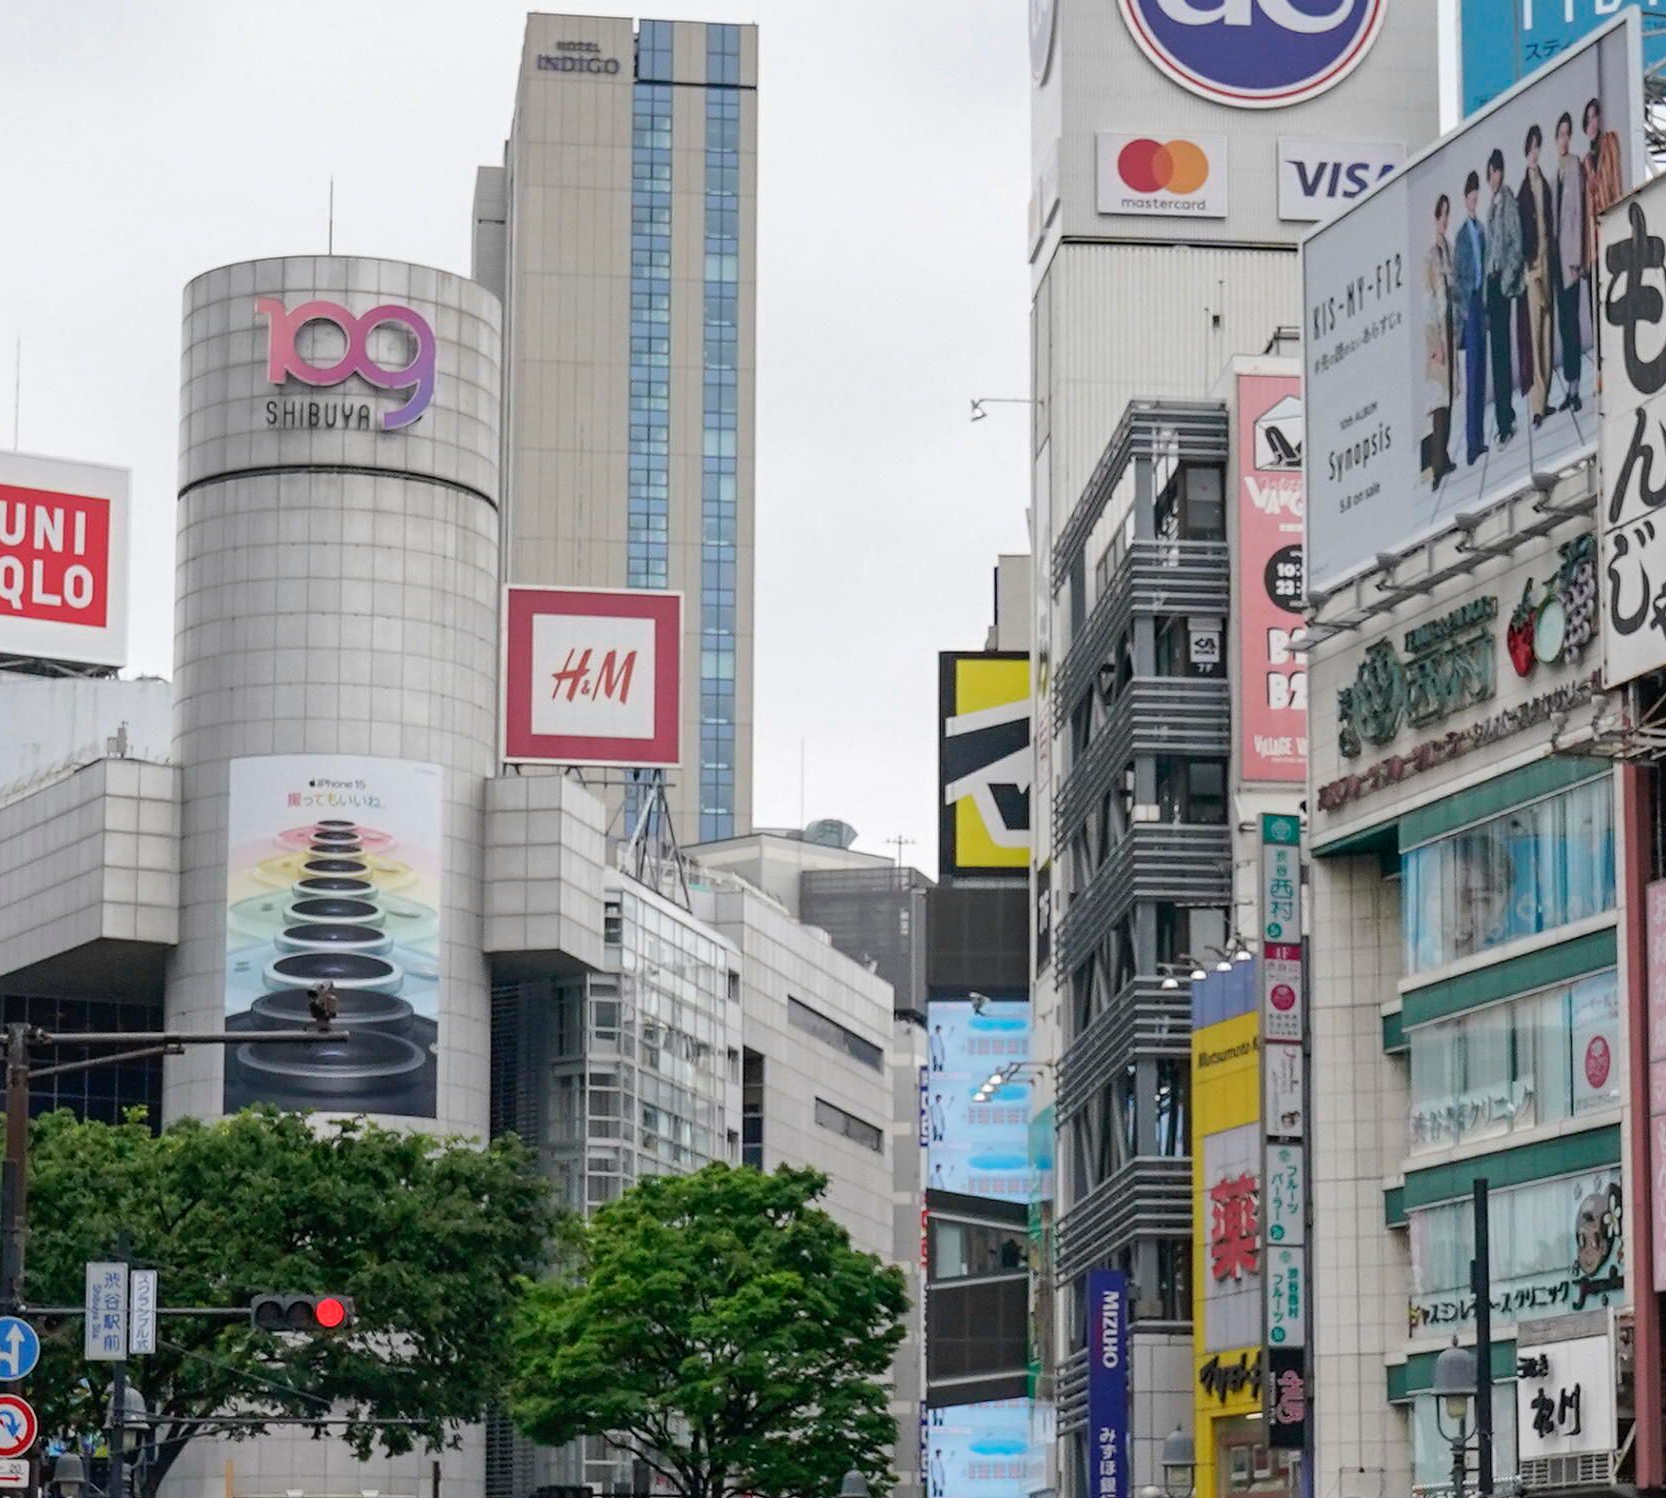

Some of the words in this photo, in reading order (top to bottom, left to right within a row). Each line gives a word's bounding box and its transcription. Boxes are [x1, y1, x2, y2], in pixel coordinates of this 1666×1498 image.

[537, 55, 619, 74] INDIGO
[1121, 198, 1206, 211] mastercard
[255, 297, 436, 430] 109
[266, 401, 371, 431] SHIBUYA
[1329, 422, 1392, 484] Synopsis
[551, 647, 637, 705] H&M
[103, 1271, 122, 1352] 渋谷駅前
[1102, 1290, 1120, 1369] MIZUHO
